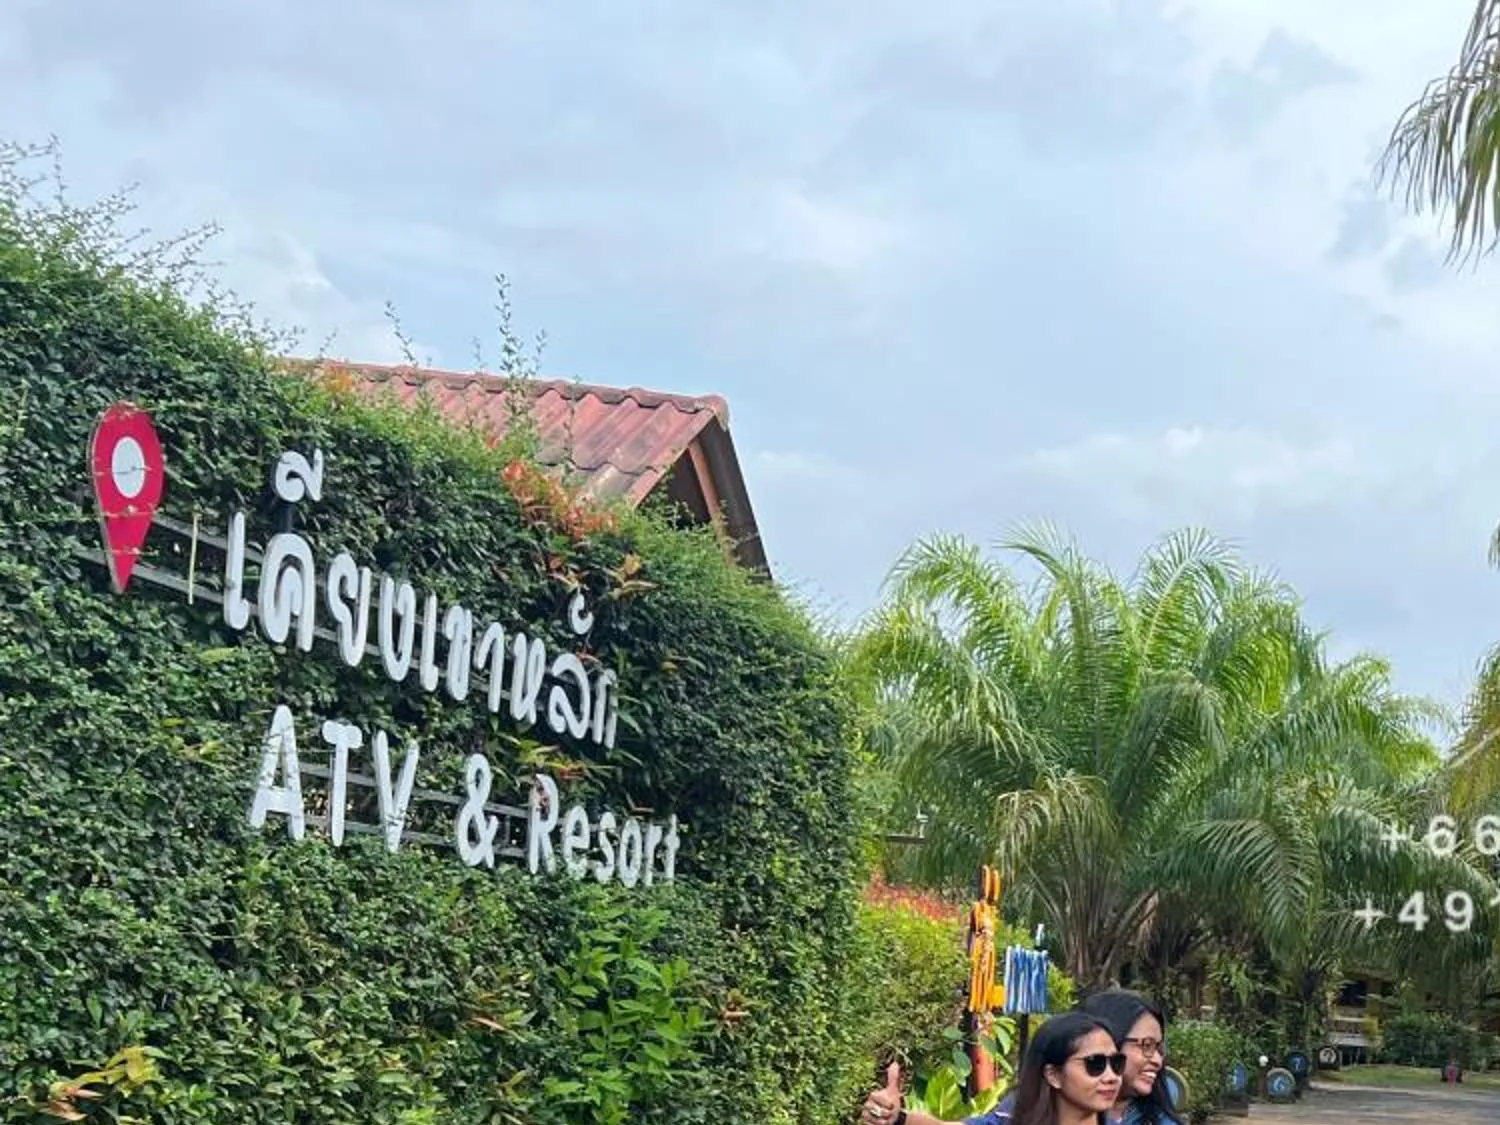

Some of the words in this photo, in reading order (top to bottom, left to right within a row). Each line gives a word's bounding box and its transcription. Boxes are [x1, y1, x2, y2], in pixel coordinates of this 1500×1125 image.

[247, 704, 421, 854] ATV
[454, 752, 500, 869] &
[527, 772, 681, 889] Resort
